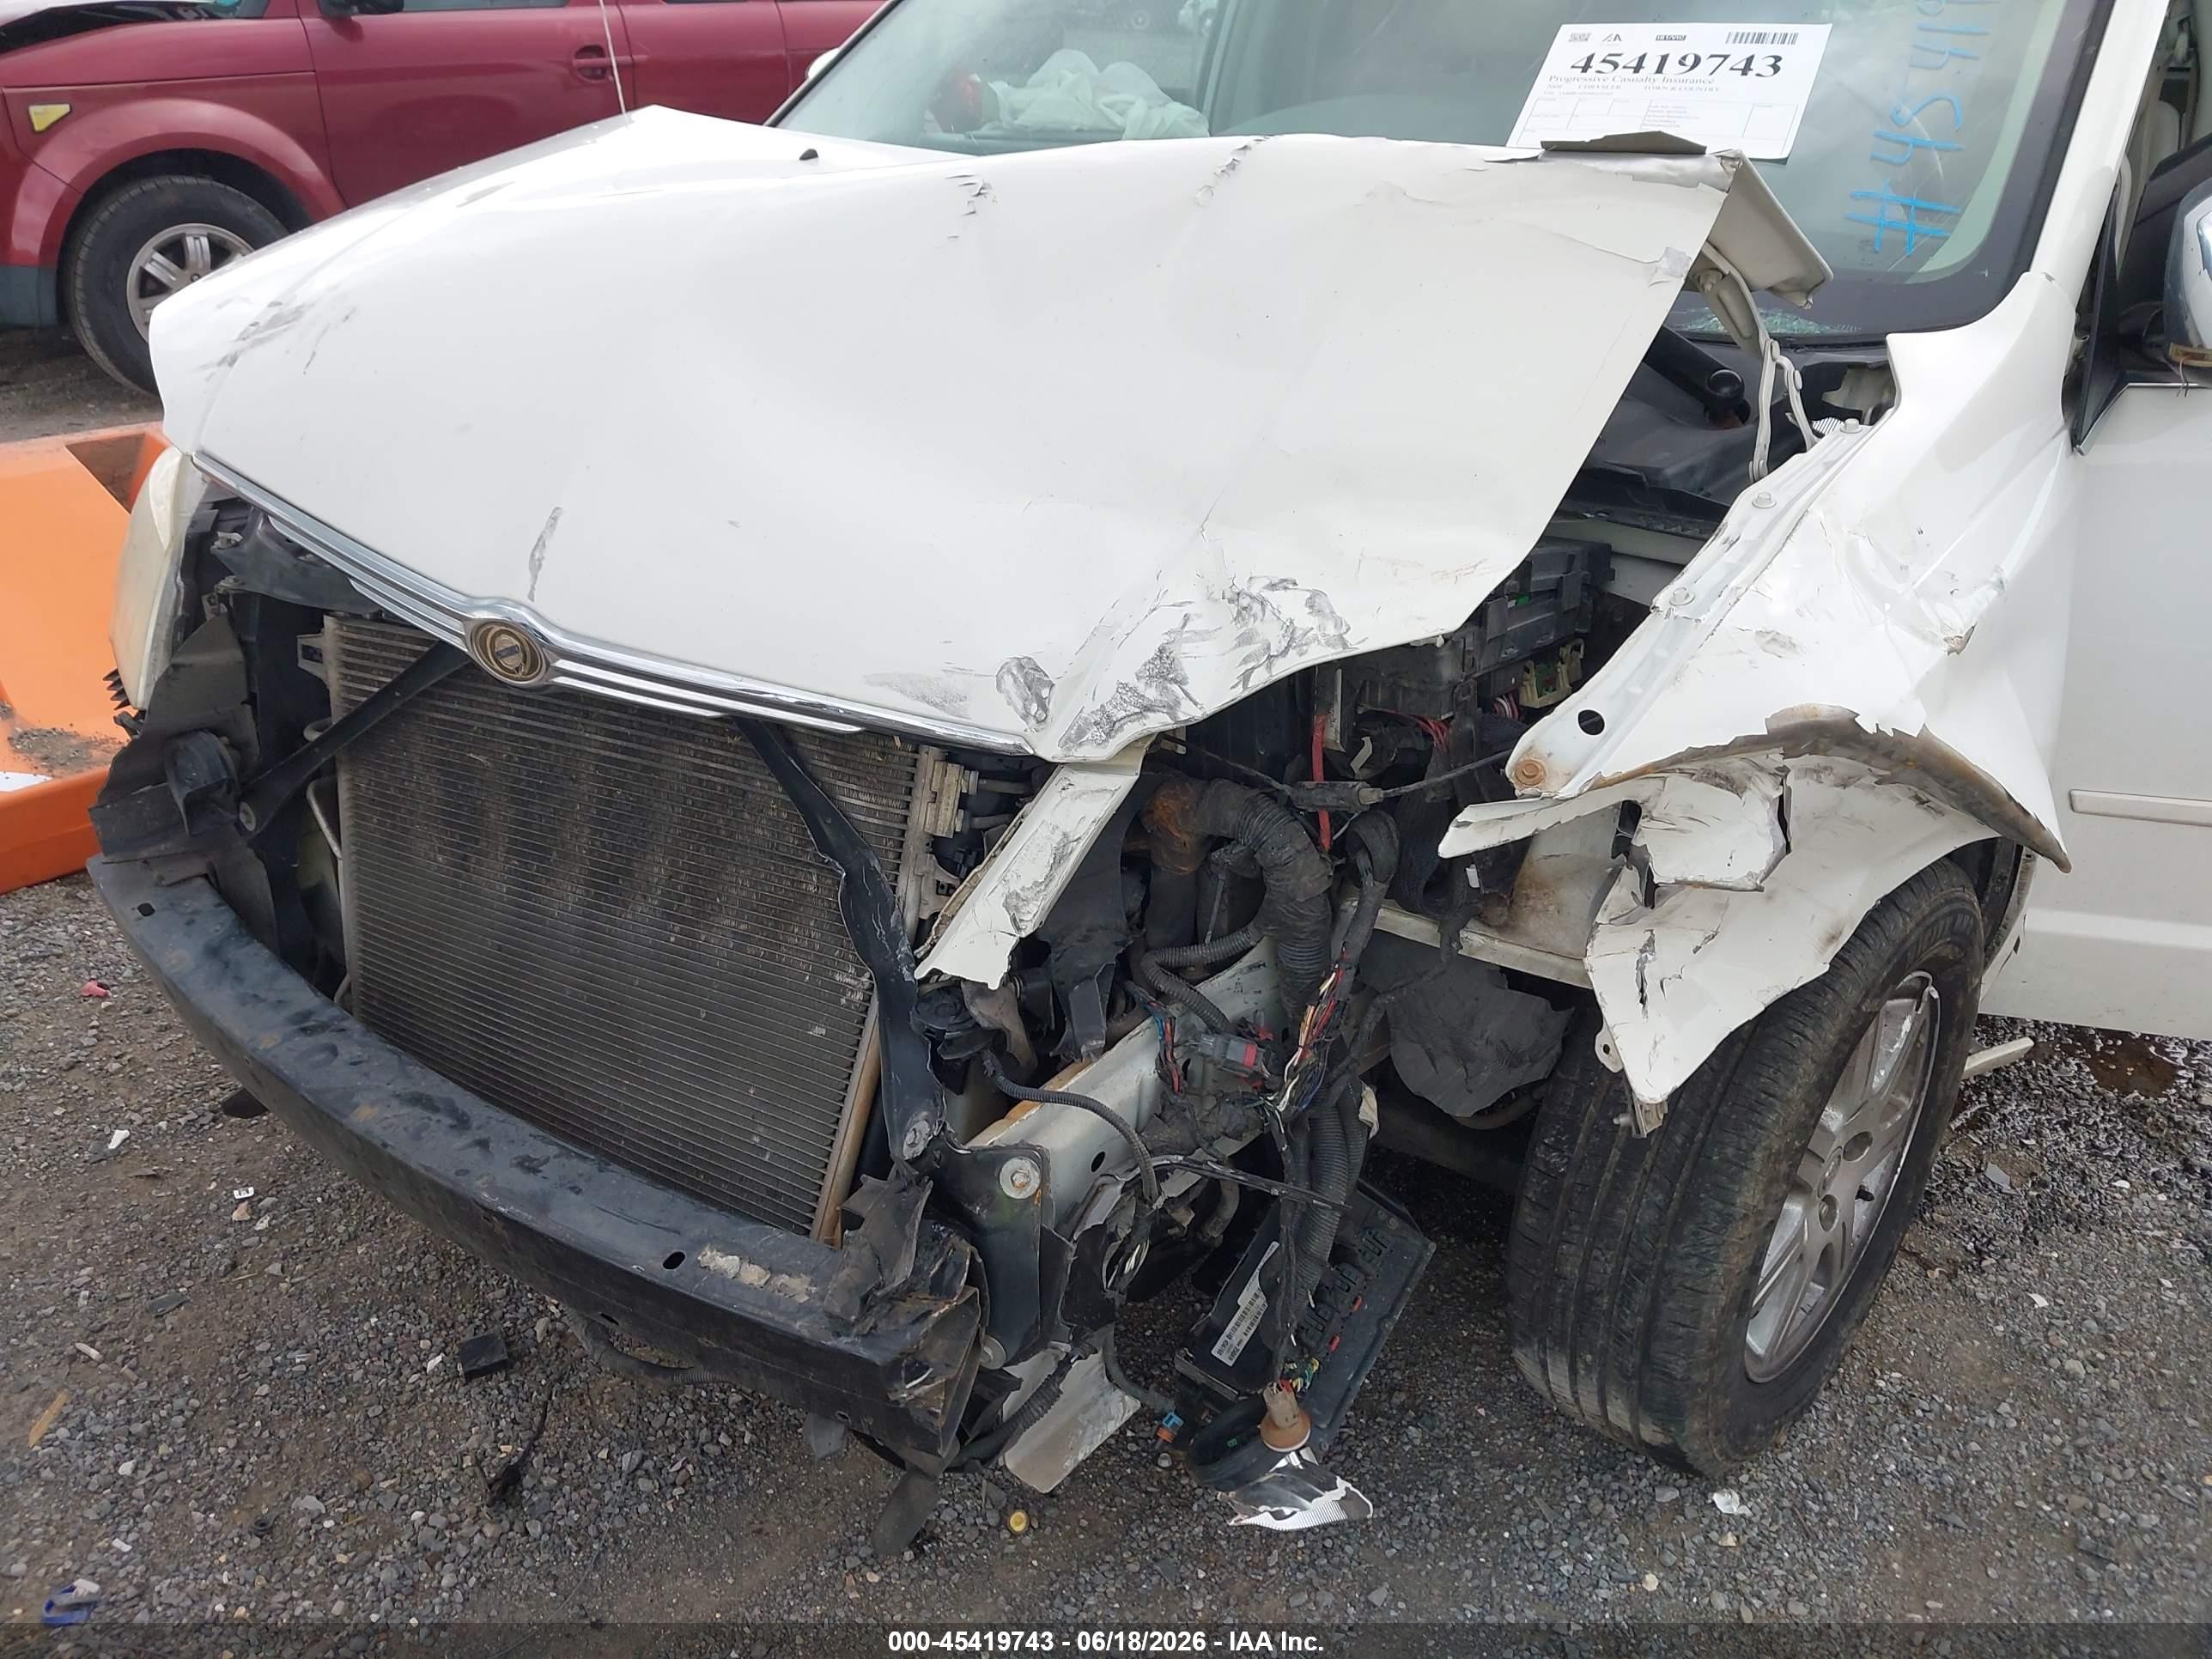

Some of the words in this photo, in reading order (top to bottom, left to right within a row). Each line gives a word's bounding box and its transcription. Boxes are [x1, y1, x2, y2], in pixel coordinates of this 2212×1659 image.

[1570, 52, 1784, 78] 45419743
[1548, 75, 1609, 84] Progressive
[1611, 76, 1656, 84] Casualty
[1662, 76, 1716, 85] Insurance
